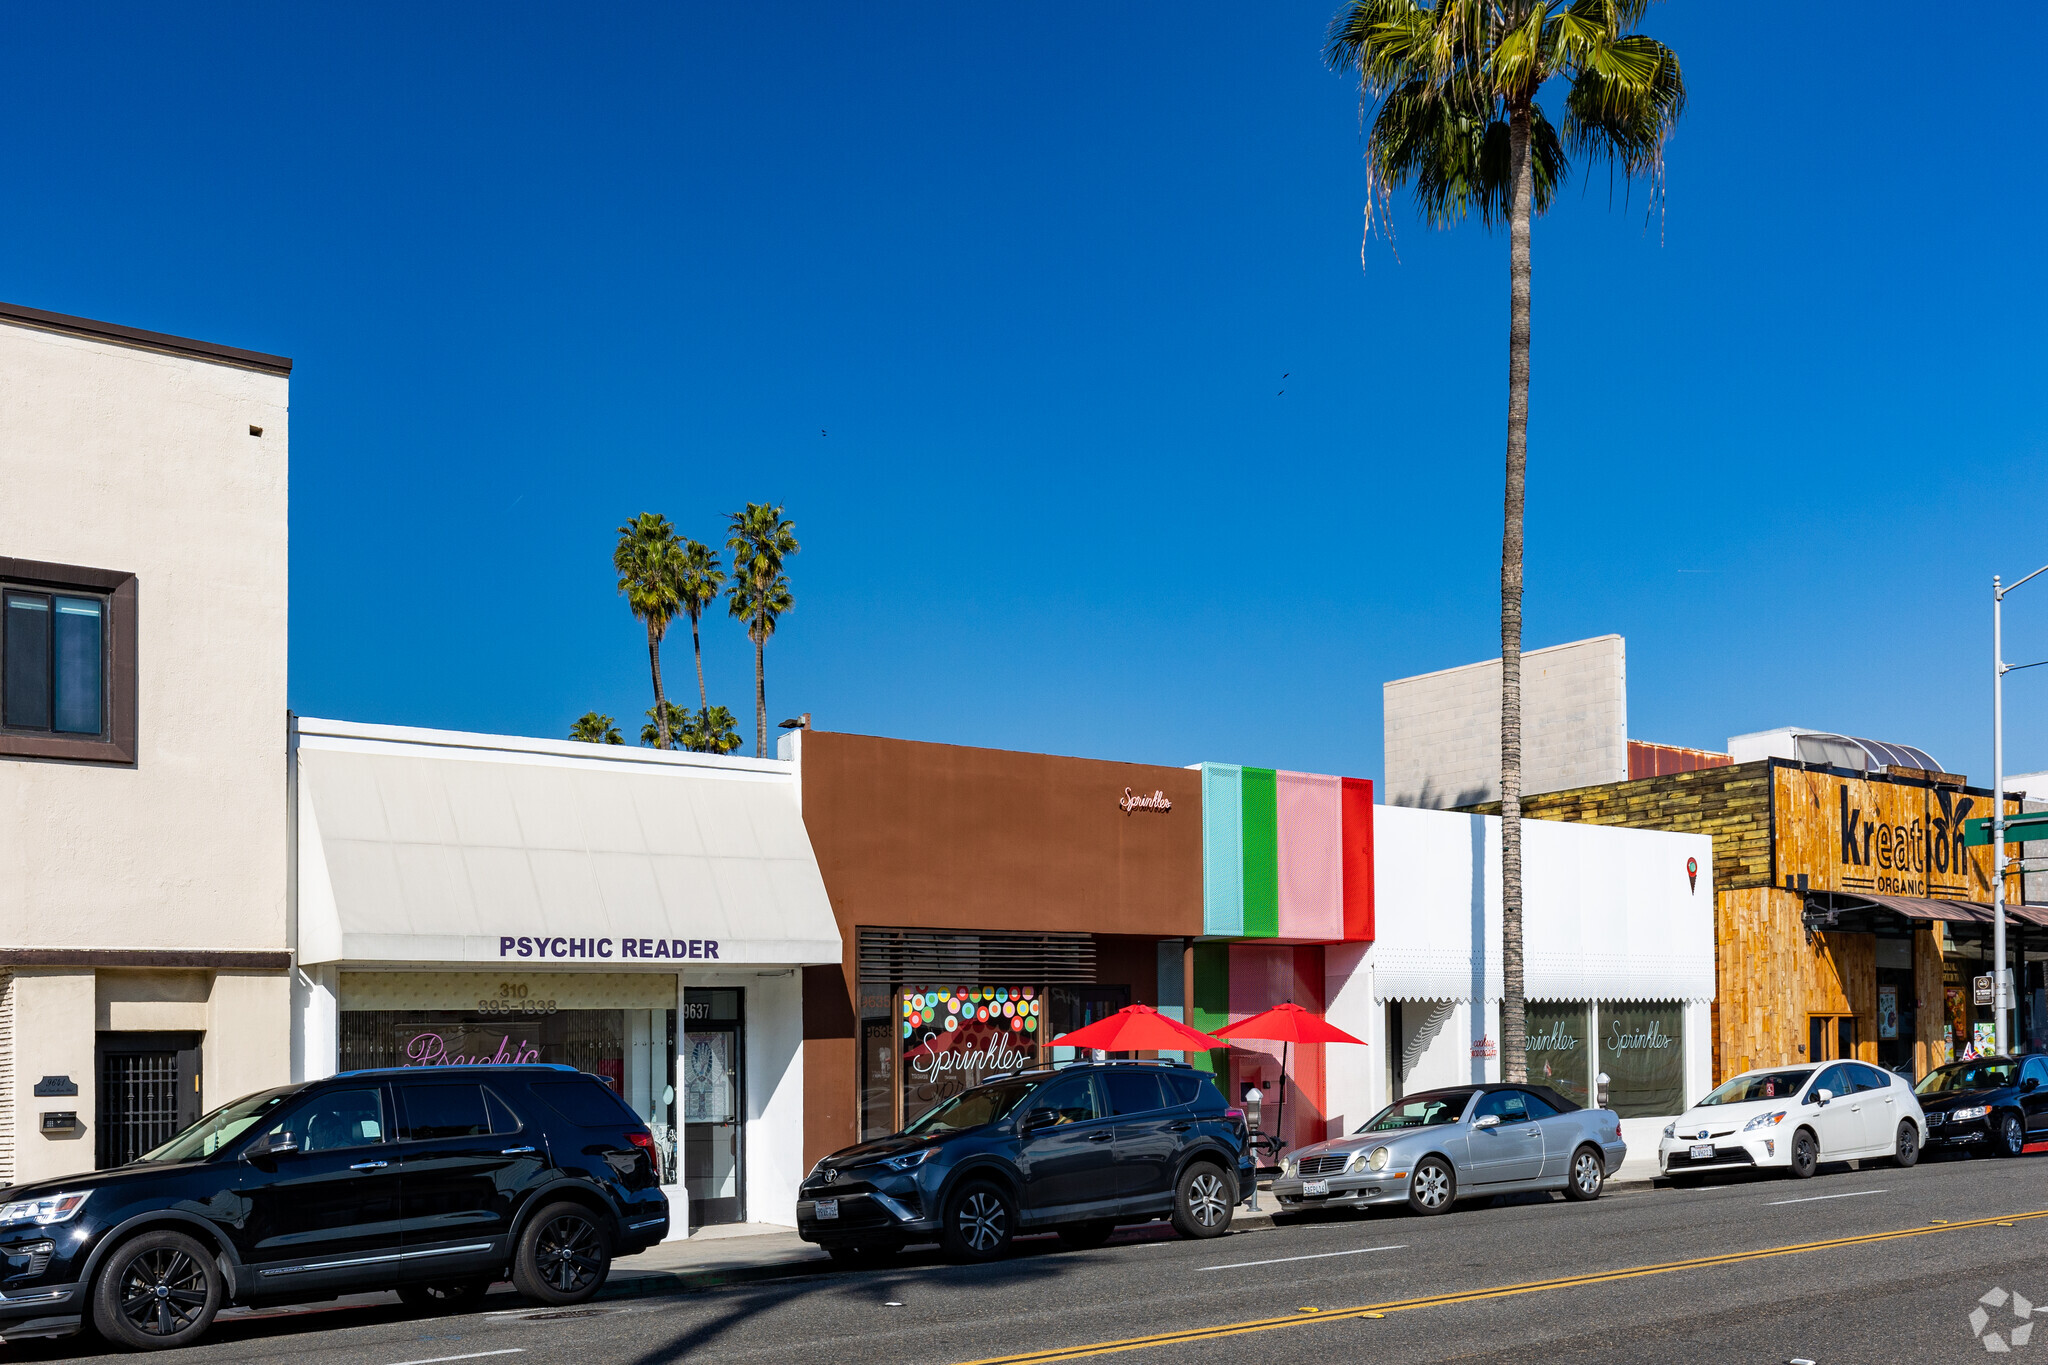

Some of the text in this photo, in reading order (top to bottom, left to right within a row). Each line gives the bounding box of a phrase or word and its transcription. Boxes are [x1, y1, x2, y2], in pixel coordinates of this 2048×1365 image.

[1120, 787, 1172, 812] Sprinkles
[1841, 785, 1968, 876] kreation
[1878, 876, 1925, 896] ORGANIC
[500, 936, 719, 959] PSYCHIC READER
[500, 983, 528, 999] 310
[478, 999, 557, 1015] 895-1338
[684, 1003, 710, 1020] 9637
[1525, 1021, 1578, 1051] rinkles
[1607, 1020, 1673, 1058] Sprinkles
[912, 1031, 1031, 1084] Sprinkles
